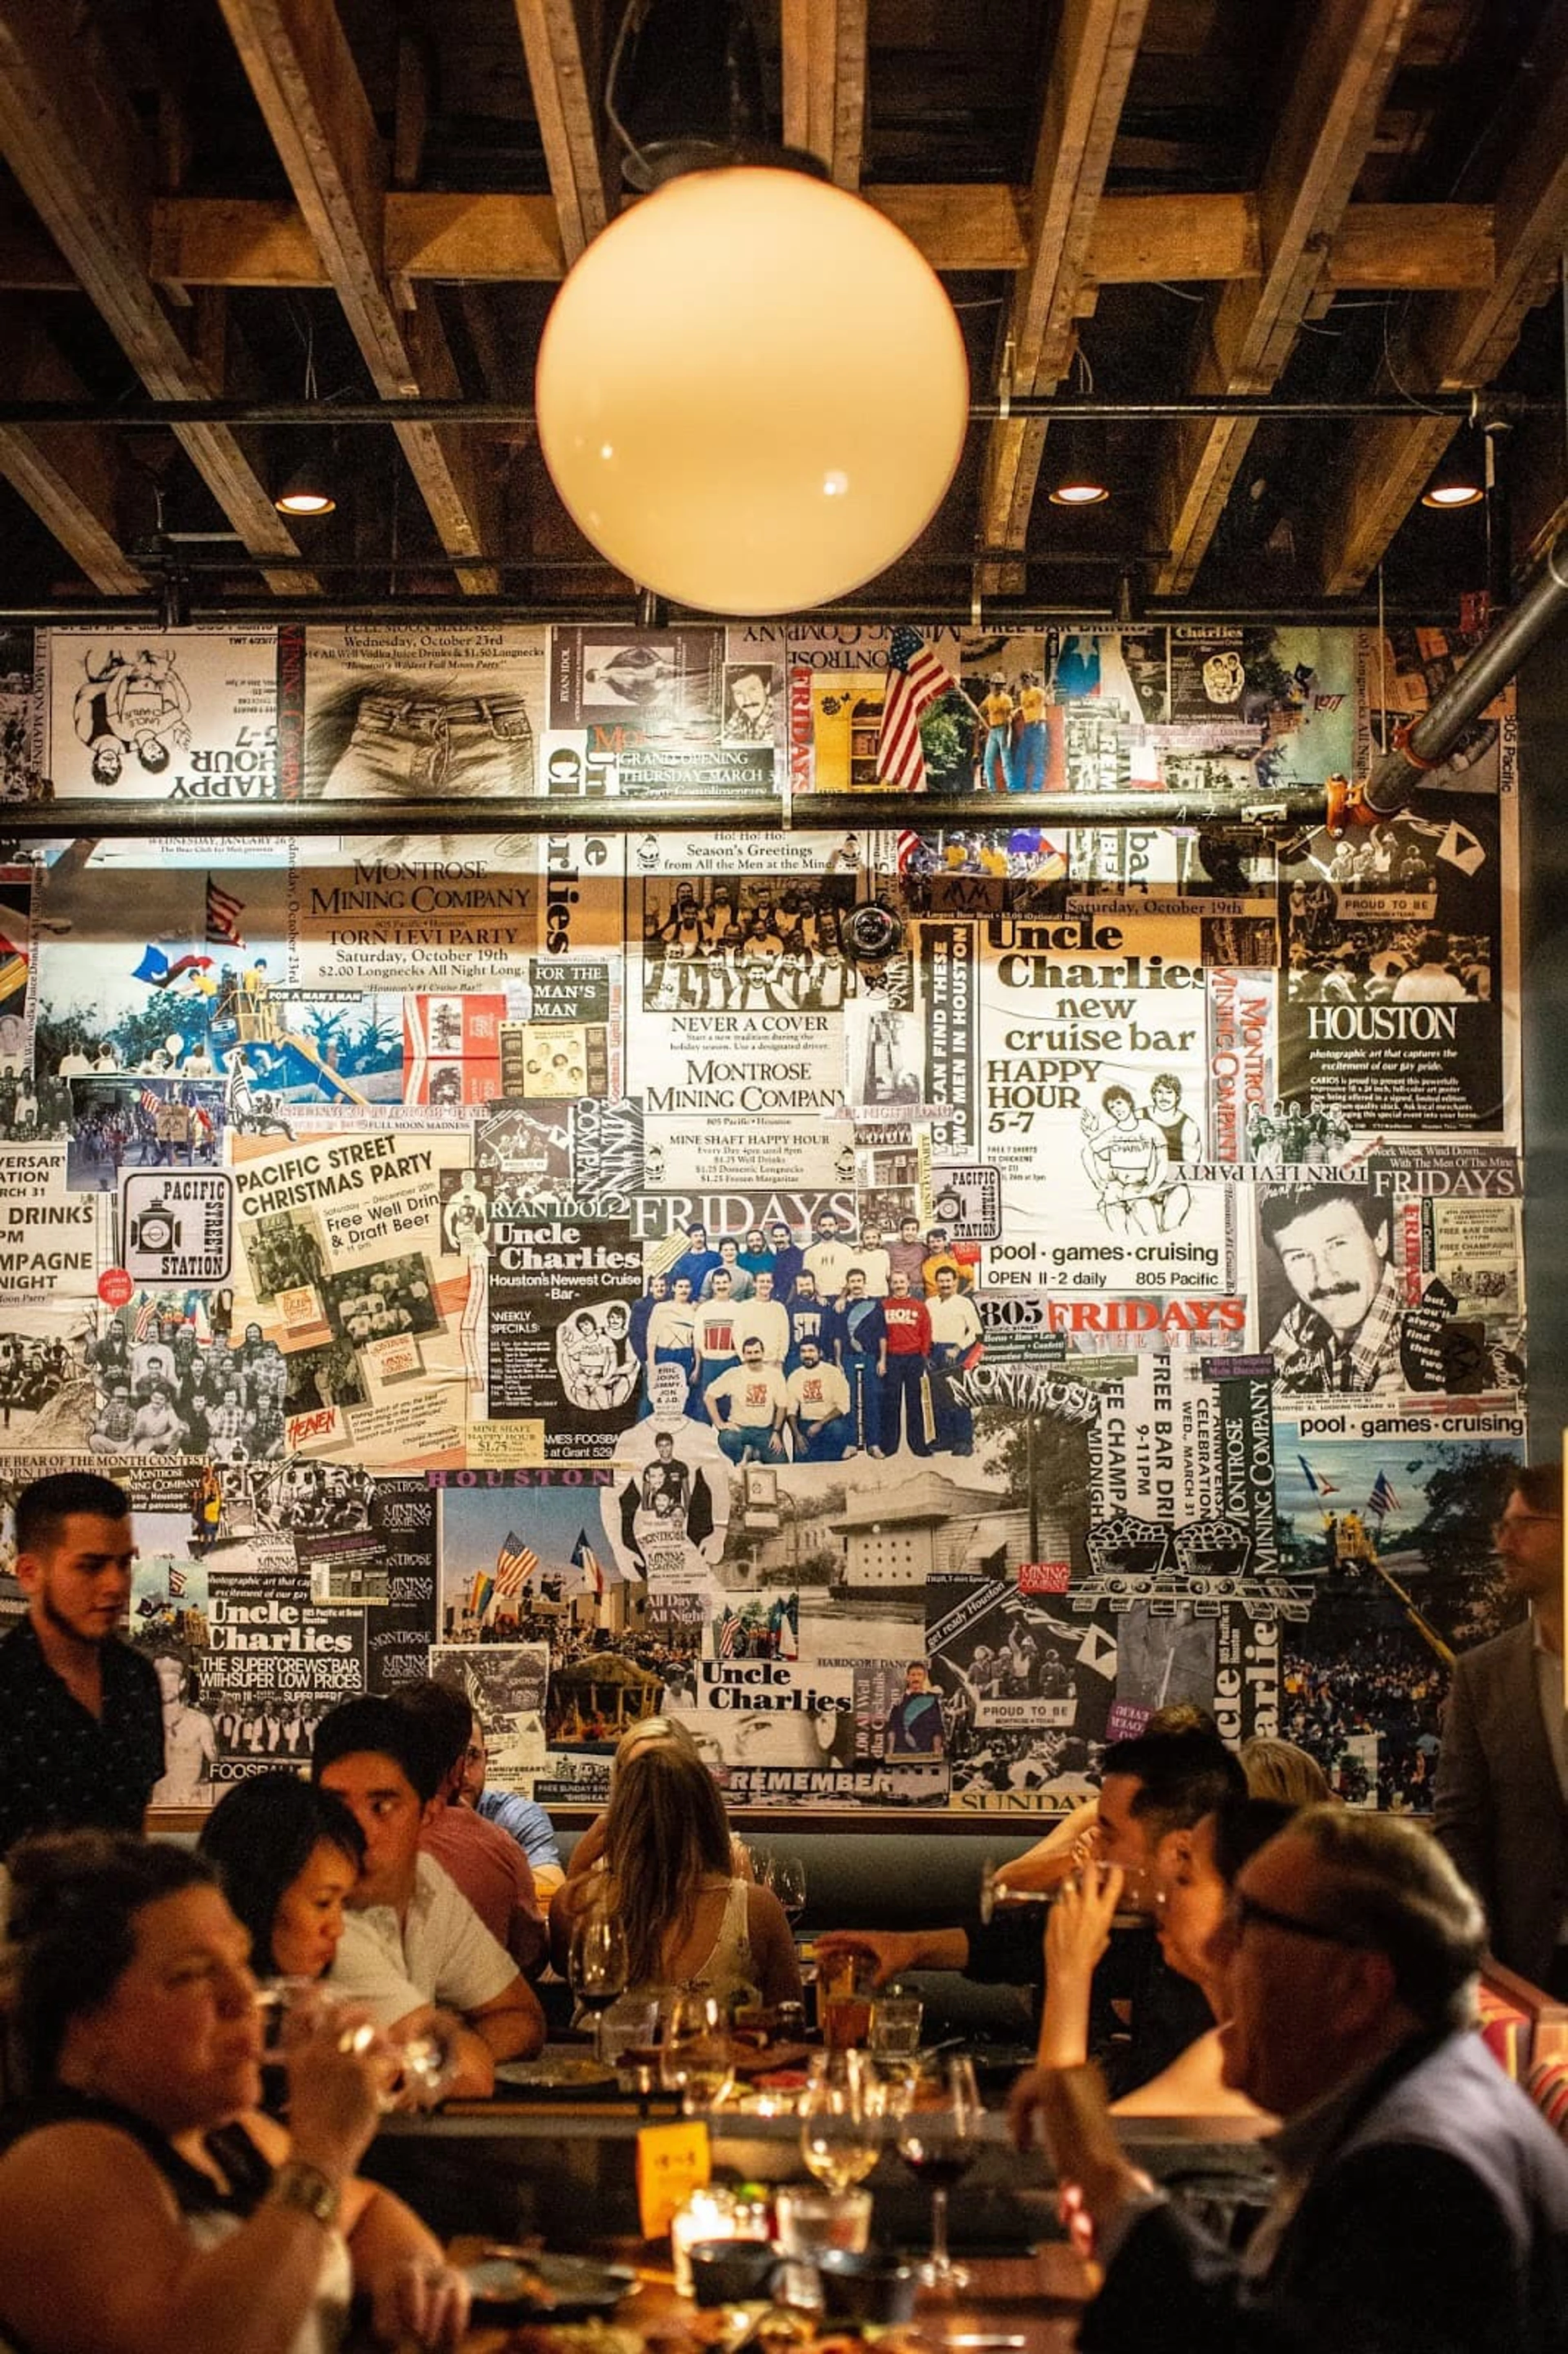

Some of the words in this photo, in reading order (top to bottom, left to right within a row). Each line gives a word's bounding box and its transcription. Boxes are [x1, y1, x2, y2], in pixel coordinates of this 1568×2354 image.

[344, 636, 416, 648] Wednesday,
[420, 635, 472, 646] October
[686, 844, 744, 856] Season's
[748, 844, 813, 857] Greetings
[354, 859, 488, 885] MONTROSE
[664, 859, 692, 870] from
[695, 860, 713, 869] All
[715, 860, 735, 869] the
[737, 860, 763, 869] Men
[766, 860, 778, 869] at
[781, 860, 799, 869] the
[312, 888, 405, 914] MINING
[411, 885, 530, 913] COMPANY
[1067, 899, 1139, 915] Saturday,
[1143, 900, 1205, 915] October
[1211, 900, 1242, 914] 19th
[1346, 900, 1385, 910] PROUD
[1392, 900, 1408, 910] TO
[1413, 900, 1428, 910] BE
[327, 930, 383, 945] TORN
[394, 930, 446, 945] LEVI
[450, 929, 518, 944] PARTY
[988, 921, 1123, 951] Uncle
[336, 950, 408, 964] Saturday,
[412, 949, 474, 962] October
[477, 950, 508, 961] 19th
[318, 966, 354, 978] $2.00
[358, 965, 425, 979] Longnecks
[428, 965, 447, 976] All
[451, 965, 487, 978] Night
[535, 967, 566, 980] FOR
[572, 967, 602, 979] THE
[934, 941, 948, 998] THESE
[953, 923, 967, 1028] HOUSTON
[533, 985, 595, 999] MAN'S
[533, 1003, 577, 1016] MAN
[1056, 998, 1137, 1019] new
[671, 1016, 735, 1032] NEVER
[743, 1016, 757, 1032] A
[762, 1016, 829, 1032] COVER
[933, 1010, 947, 1054] FIND
[1307, 1006, 1457, 1040] HOUSTON
[953, 1030, 967, 1052] IN
[1005, 1023, 1123, 1051] cruise
[1129, 1021, 1196, 1051] bar
[1309, 1049, 1367, 1061] photographic
[1368, 1050, 1382, 1058] art
[1383, 1050, 1402, 1058] that
[1403, 1050, 1441, 1060] captures
[1443, 1049, 1458, 1058] the
[686, 1060, 813, 1084] MONTROSE
[988, 1060, 1101, 1083] HAPPY
[953, 1061, 967, 1104] MEN
[646, 1086, 734, 1112] MINING
[988, 1086, 1081, 1108] HOUR
[953, 1109, 968, 1156] TWO
[988, 1112, 1035, 1133] 5-7
[670, 1135, 703, 1144] MINE
[704, 1135, 744, 1144] SHAFT
[747, 1135, 789, 1144] HAPPY
[793, 1135, 829, 1144] HOUR
[236, 1155, 321, 1193] PACIFIC
[327, 1134, 396, 1168] STREET
[1174, 1165, 1250, 1181] PARTY
[1252, 1166, 1299, 1181] LEVI
[1390, 1158, 1412, 1168] With
[1414, 1158, 1432, 1168] The
[1434, 1158, 1453, 1168] Men
[1455, 1158, 1468, 1168] Of
[1469, 1158, 1488, 1168] The
[241, 1170, 364, 1217] CHRISTMAS
[370, 1150, 433, 1184] PARTY
[952, 1172, 996, 1185] PACIFIC
[1373, 1169, 1515, 1197] FRIDAYS
[164, 1181, 224, 1200] PACIFIC
[8, 1206, 93, 1224] DRINKS
[326, 1213, 362, 1232] Free
[367, 1200, 402, 1224] Well
[490, 1202, 548, 1218] RYAN
[557, 1202, 608, 1218] IDOL
[631, 1192, 855, 1237] FRIDAYS
[204, 1202, 224, 1255] STREET
[331, 1234, 343, 1249] &
[347, 1224, 388, 1246] Draft
[392, 1211, 430, 1231] Beer
[494, 1222, 580, 1245] Uncle
[953, 1223, 996, 1237] STATION
[500, 1246, 641, 1270] Charlies
[990, 1242, 1036, 1264] pool
[1052, 1246, 1124, 1266] games
[1135, 1242, 1218, 1266] cruising
[1403, 1202, 1421, 1307] FRIDAYS
[161, 1256, 223, 1275] STATION
[490, 1272, 550, 1286] Houston's
[550, 1275, 599, 1286] Newest
[601, 1274, 641, 1286] Cruise
[988, 1271, 1031, 1285] OPEN
[1073, 1270, 1107, 1288] daily
[1136, 1271, 1167, 1286] 805
[1170, 1271, 1218, 1285] Pacific
[491, 1311, 531, 1321] WEEKLY
[980, 1299, 1043, 1326] 805
[1048, 1299, 1246, 1333] FRIDAYS
[1406, 1329, 1431, 1343] find
[1420, 1358, 1443, 1371] two
[1153, 1354, 1172, 1411] FREE
[287, 1409, 336, 1450] HEAVEN
[1250, 1380, 1276, 1487] COMPANY
[1301, 1416, 1345, 1438] pool
[1361, 1418, 1431, 1437] games
[1442, 1414, 1524, 1436] cruising
[1155, 1421, 1173, 1470] BAR
[13, 1456, 48, 1467] BEAR
[49, 1456, 67, 1466] OF
[70, 1456, 96, 1467] THE
[99, 1456, 147, 1466] MONTH
[1136, 1425, 1151, 1496] 9-11PM
[1197, 1399, 1212, 1520] CELEBRATION
[129, 1469, 183, 1479] MONTROSE
[152, 1478, 201, 1491] COMPANY
[427, 1469, 611, 1487] HOUSTON
[1254, 1493, 1278, 1576] MINING
[650, 1610, 667, 1622] All
[671, 1610, 706, 1624] Night
[209, 1626, 353, 1653] Charlies
[201, 1657, 228, 1673] THE
[701, 1662, 791, 1685] Uncle
[232, 1674, 274, 1688] SUPER
[278, 1674, 310, 1689] LOW
[314, 1674, 362, 1689] PRICES
[709, 1687, 852, 1712] Charlies
[983, 1706, 1023, 1716] PROUD
[1031, 1706, 1047, 1716] TO
[1052, 1706, 1068, 1716] BE
[730, 1773, 895, 1792] REMEMBER
